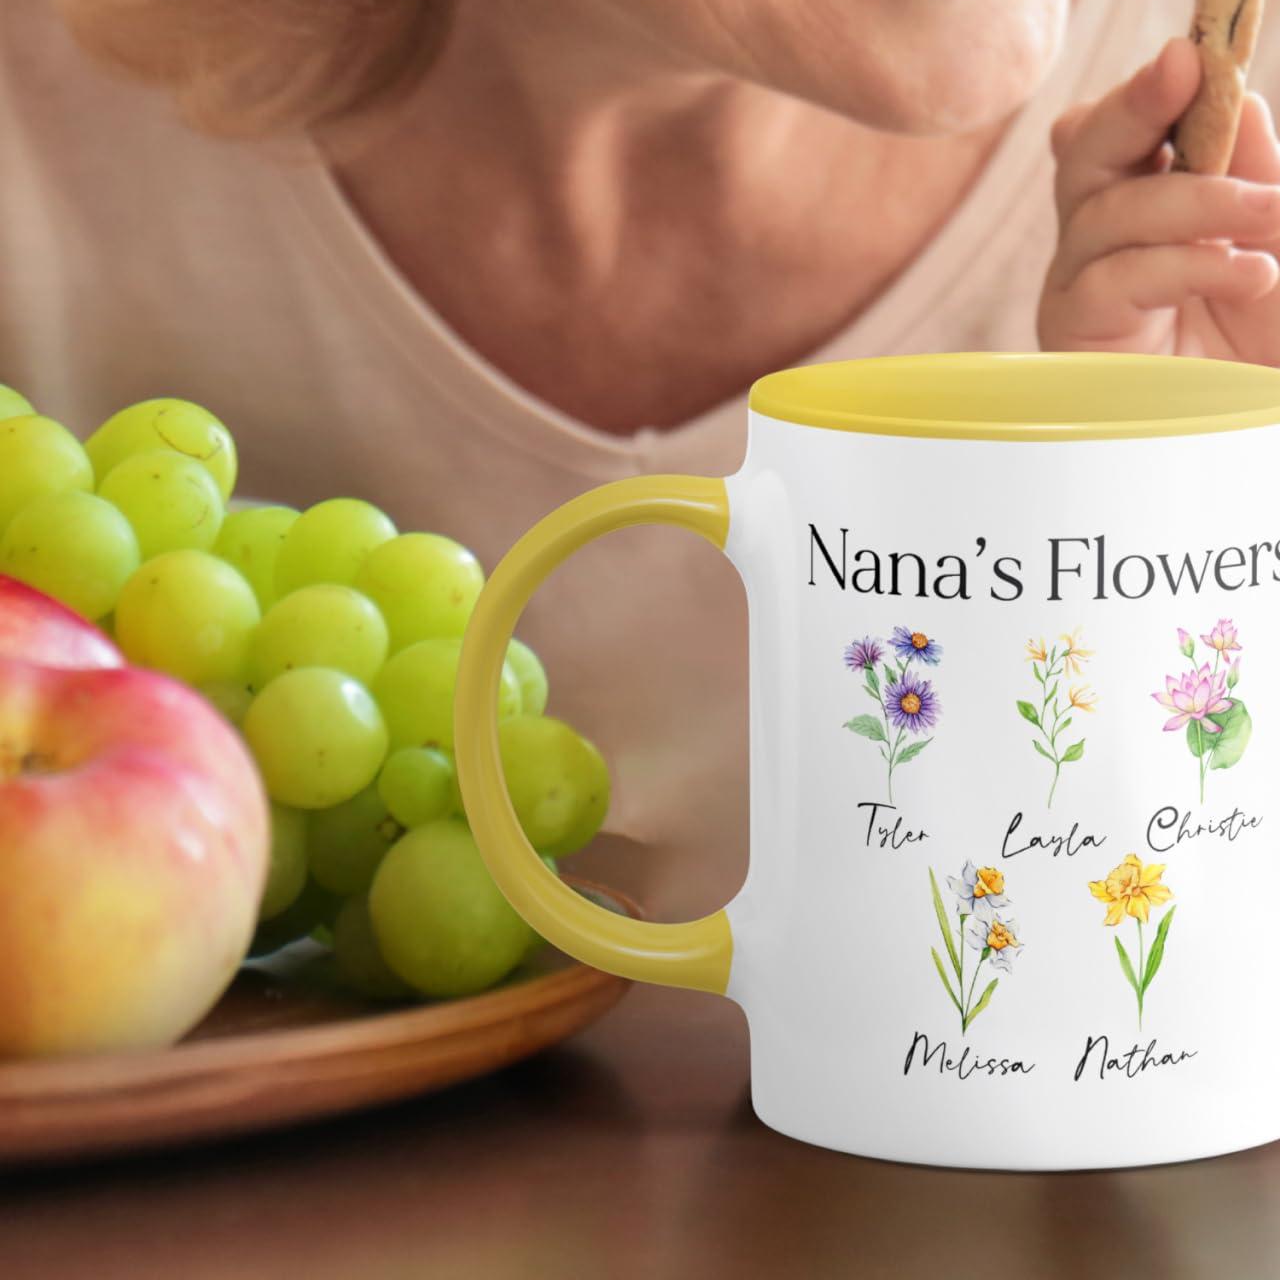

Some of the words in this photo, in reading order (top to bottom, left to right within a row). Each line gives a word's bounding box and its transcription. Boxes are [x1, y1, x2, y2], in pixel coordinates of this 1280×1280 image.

[808, 523, 1024, 601] Nana’s
[857, 802, 930, 850] Tyler
[1001, 812, 1107, 858] Layla
[1146, 806, 1264, 852] Christie
[904, 1031, 1036, 1080] Melissa
[1074, 1035, 1198, 1081] Nathan
